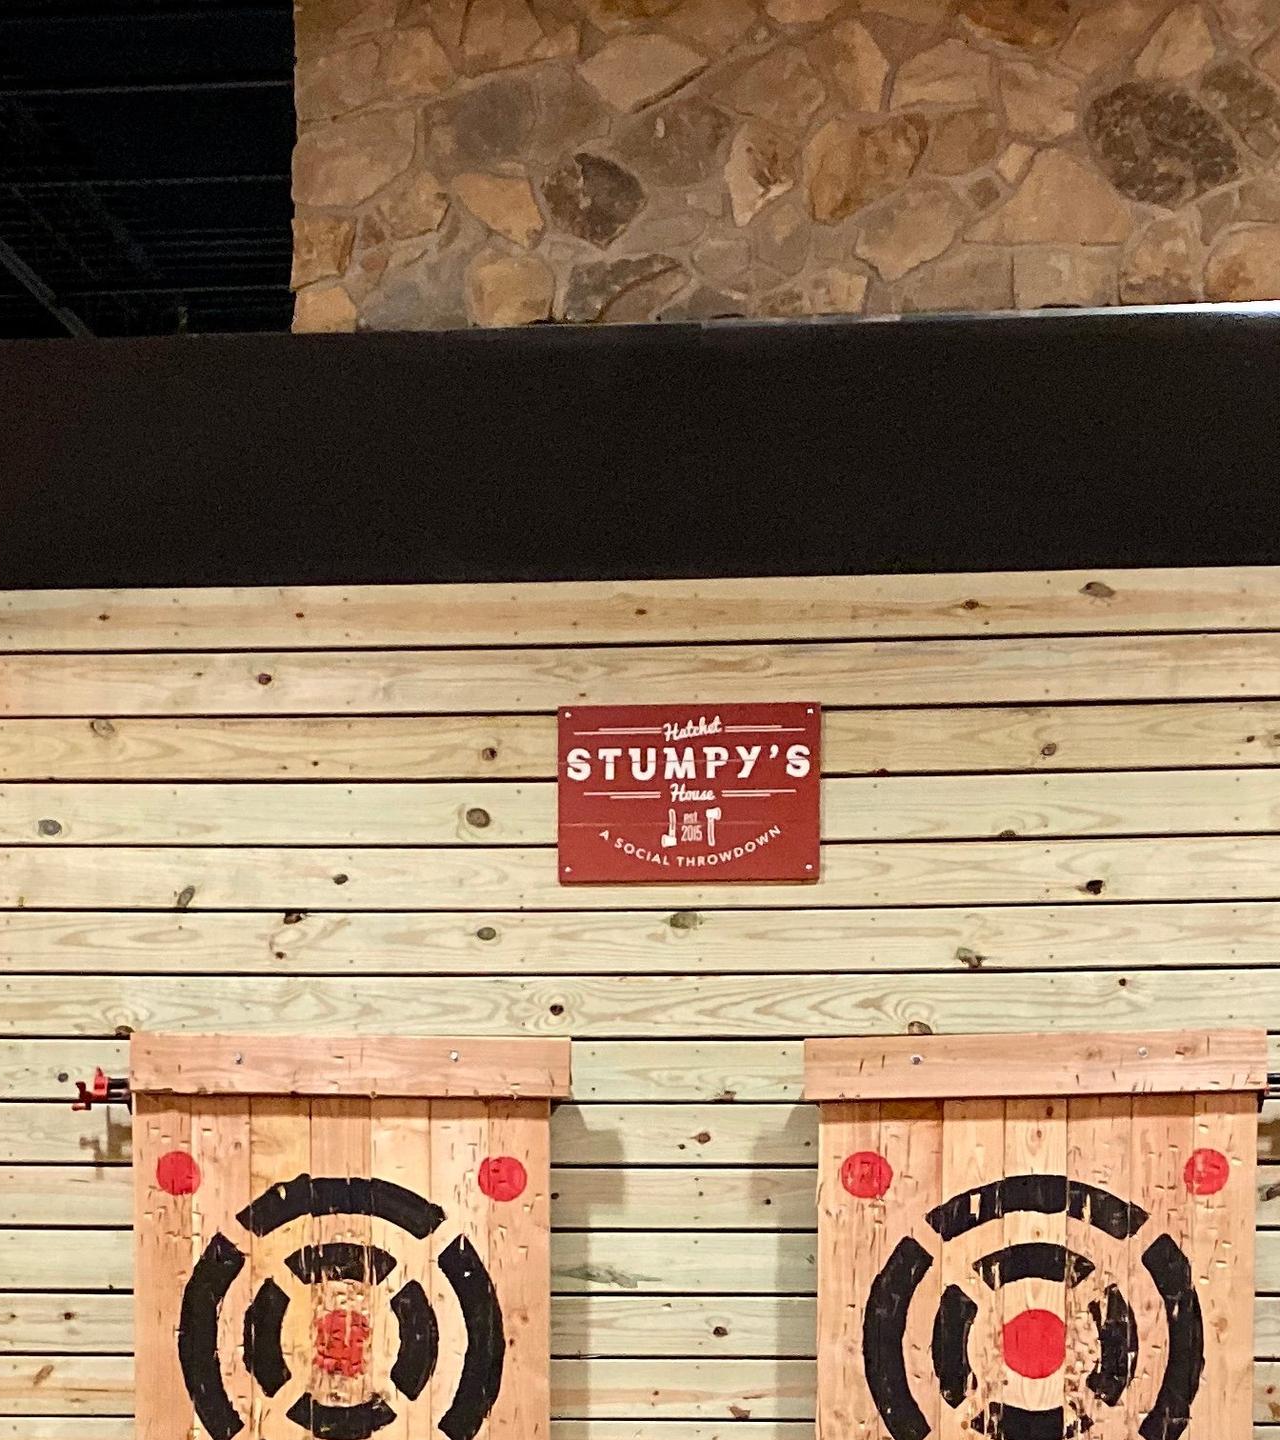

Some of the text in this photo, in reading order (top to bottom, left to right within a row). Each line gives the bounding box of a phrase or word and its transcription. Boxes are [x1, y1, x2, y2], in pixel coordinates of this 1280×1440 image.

[663, 716, 722, 741] Hatchet
[566, 744, 811, 781] STUMPY'S
[670, 783, 716, 802] House
[681, 824, 703, 842] 2015
[599, 825, 781, 867] A SOCIAL THROWDOWN
